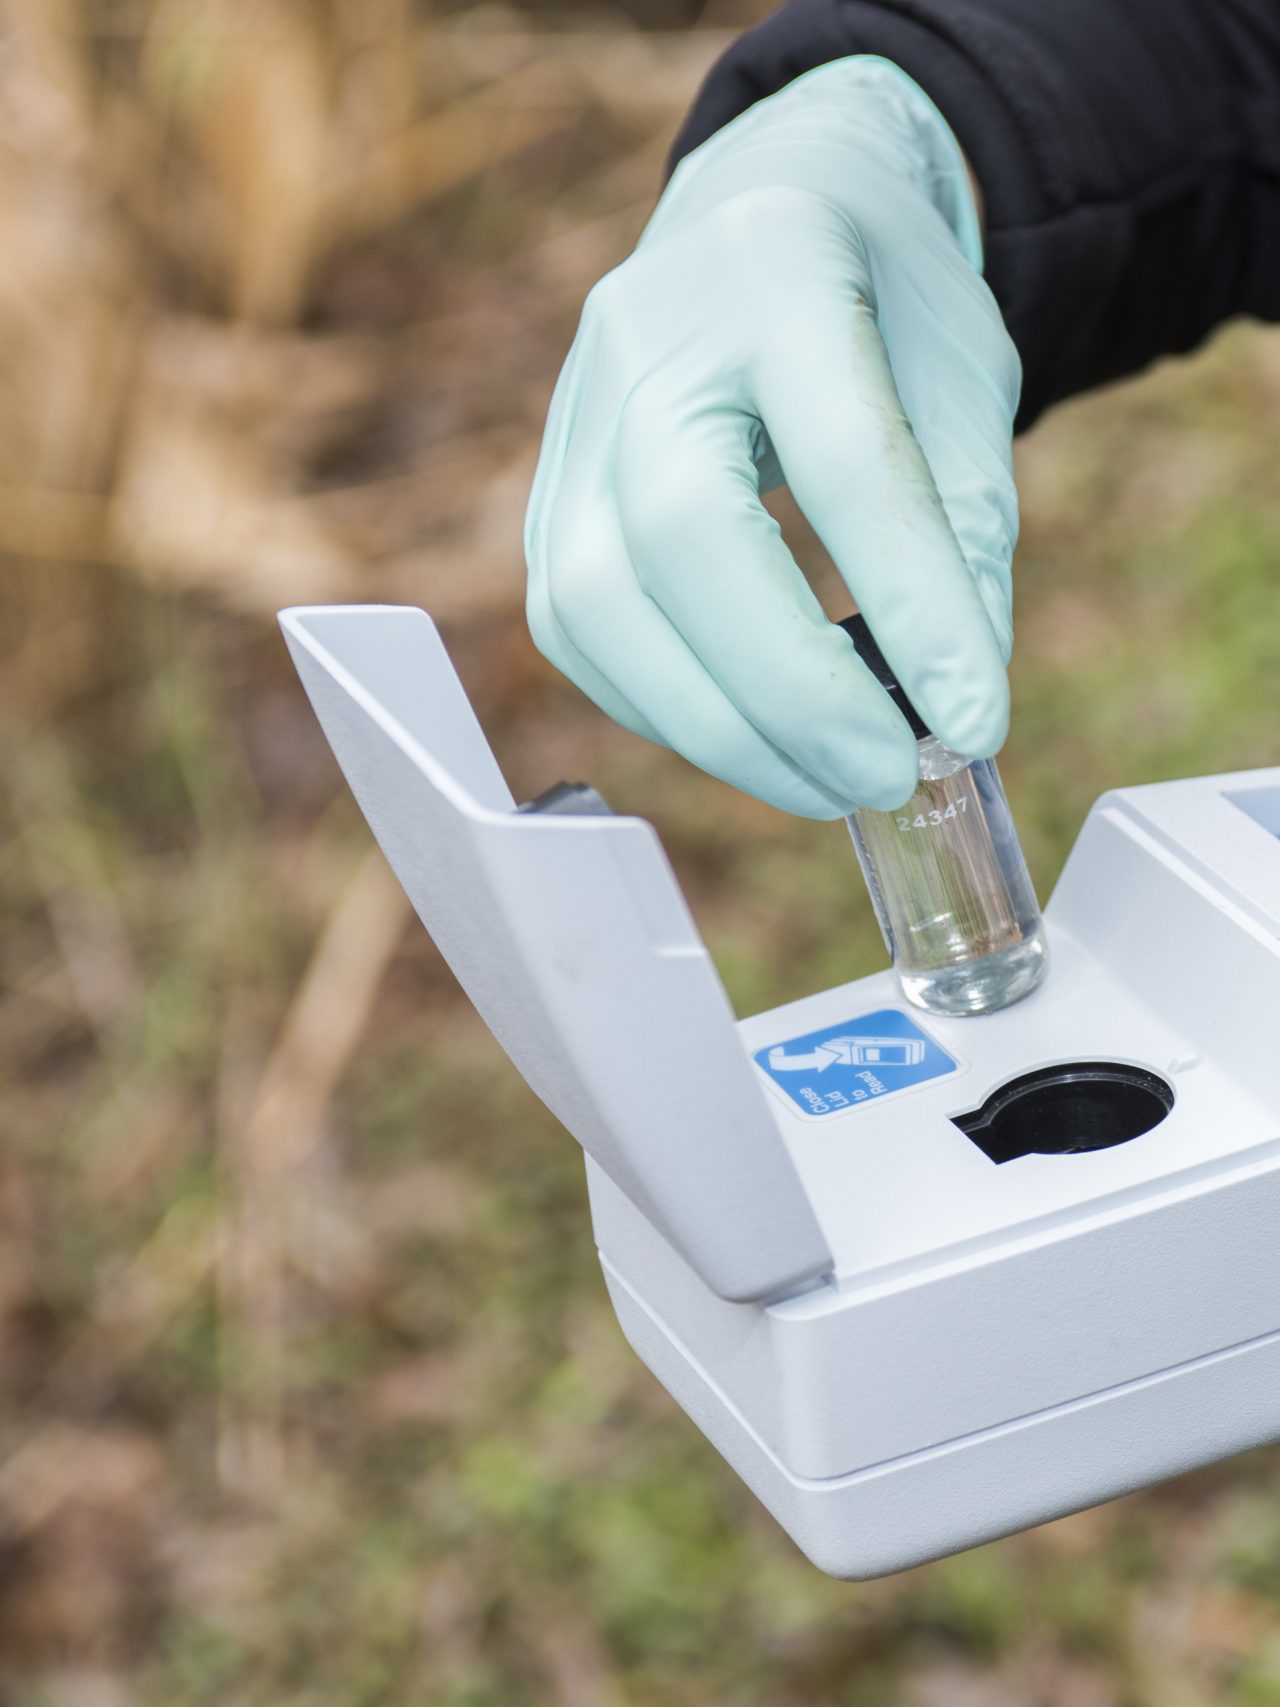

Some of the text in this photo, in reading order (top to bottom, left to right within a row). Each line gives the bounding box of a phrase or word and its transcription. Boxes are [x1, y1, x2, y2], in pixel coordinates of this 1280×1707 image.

[896, 796, 967, 831] 24347
[852, 1089, 868, 1101] to
[855, 1070, 888, 1095] Read
[800, 1087, 830, 1113] Close
[824, 1090, 850, 1108] Lid
